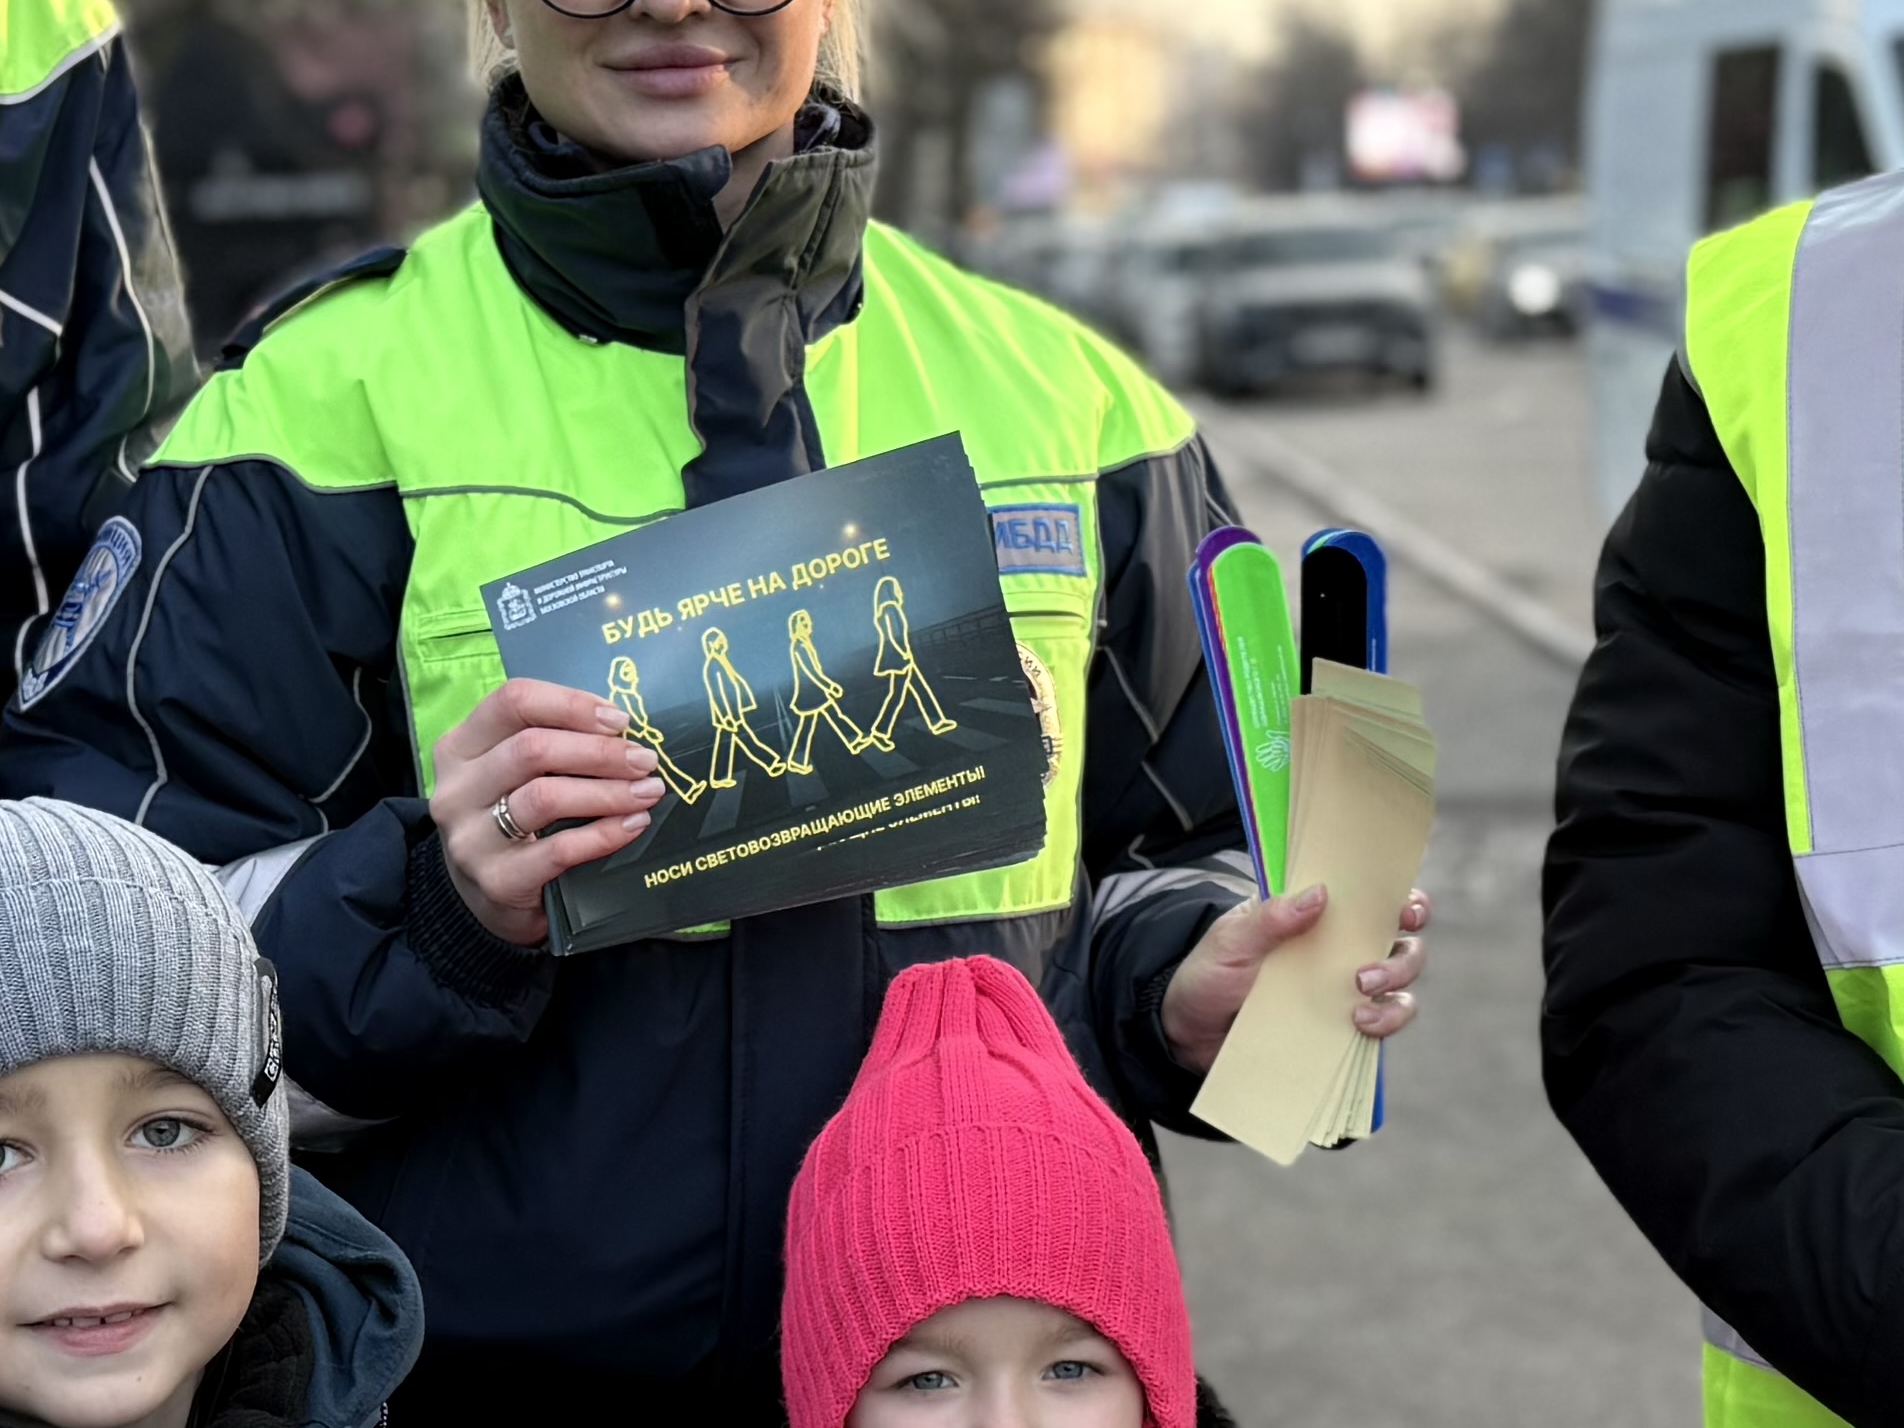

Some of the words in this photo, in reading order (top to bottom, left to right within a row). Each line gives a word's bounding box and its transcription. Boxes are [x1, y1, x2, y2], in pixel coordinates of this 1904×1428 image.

[996, 518, 1073, 554] ИБДД
[601, 604, 673, 645] БУДЬ
[677, 584, 745, 623] ЯРЧЕ
[748, 568, 788, 599] НА
[792, 538, 891, 590] ДОРОГЕ
[644, 860, 694, 888] НОСИ
[695, 796, 892, 872] СВЕТОВОЗВРАЩАЮЩИЕ
